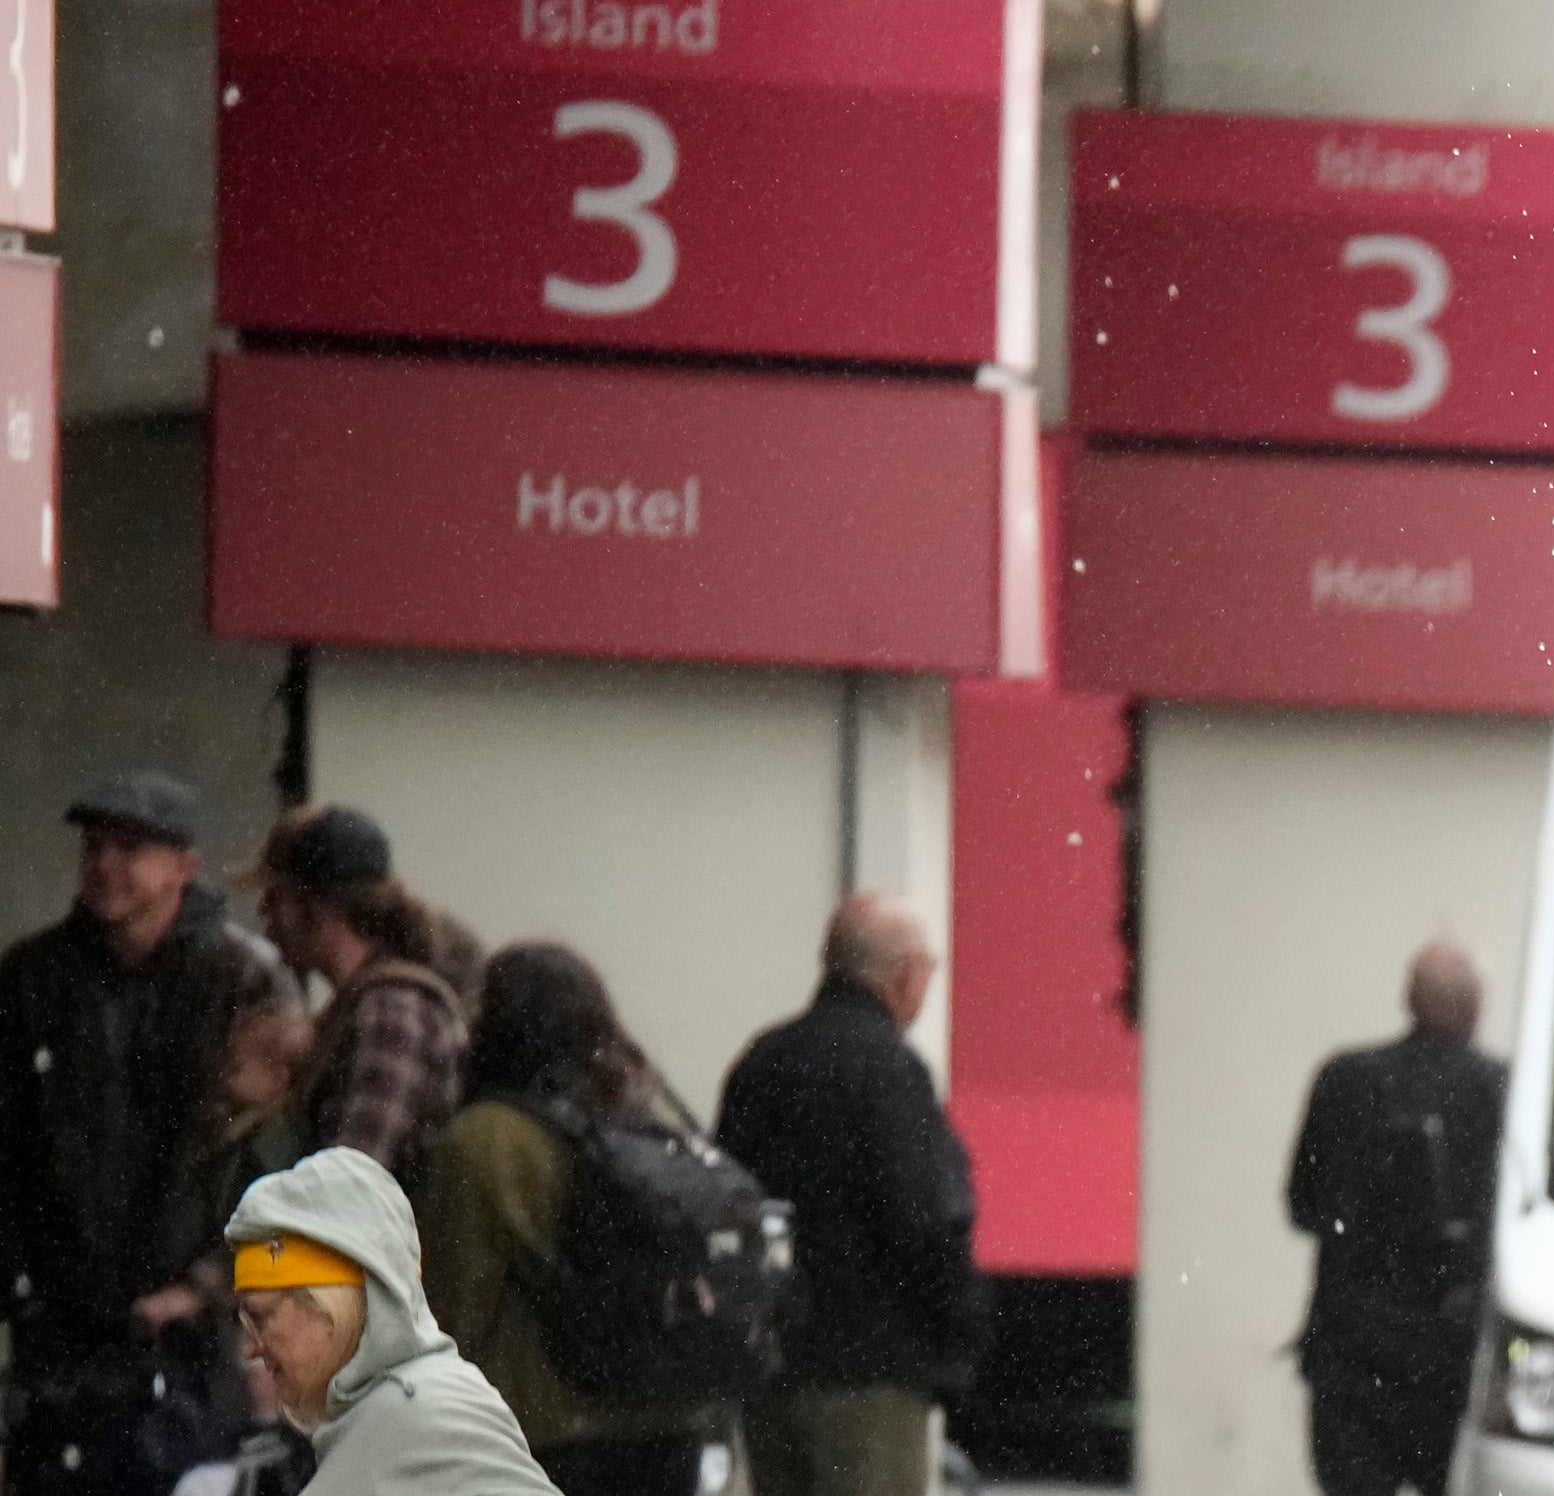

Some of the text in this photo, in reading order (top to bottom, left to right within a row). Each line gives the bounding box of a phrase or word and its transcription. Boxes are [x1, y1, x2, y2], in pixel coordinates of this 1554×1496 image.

[519, 0, 719, 54] Island
[1314, 136, 1488, 197] Island
[542, 99, 682, 319] 3
[1329, 232, 1453, 422] 3
[516, 470, 702, 537] Hotel
[1309, 554, 1474, 614] Hotel
